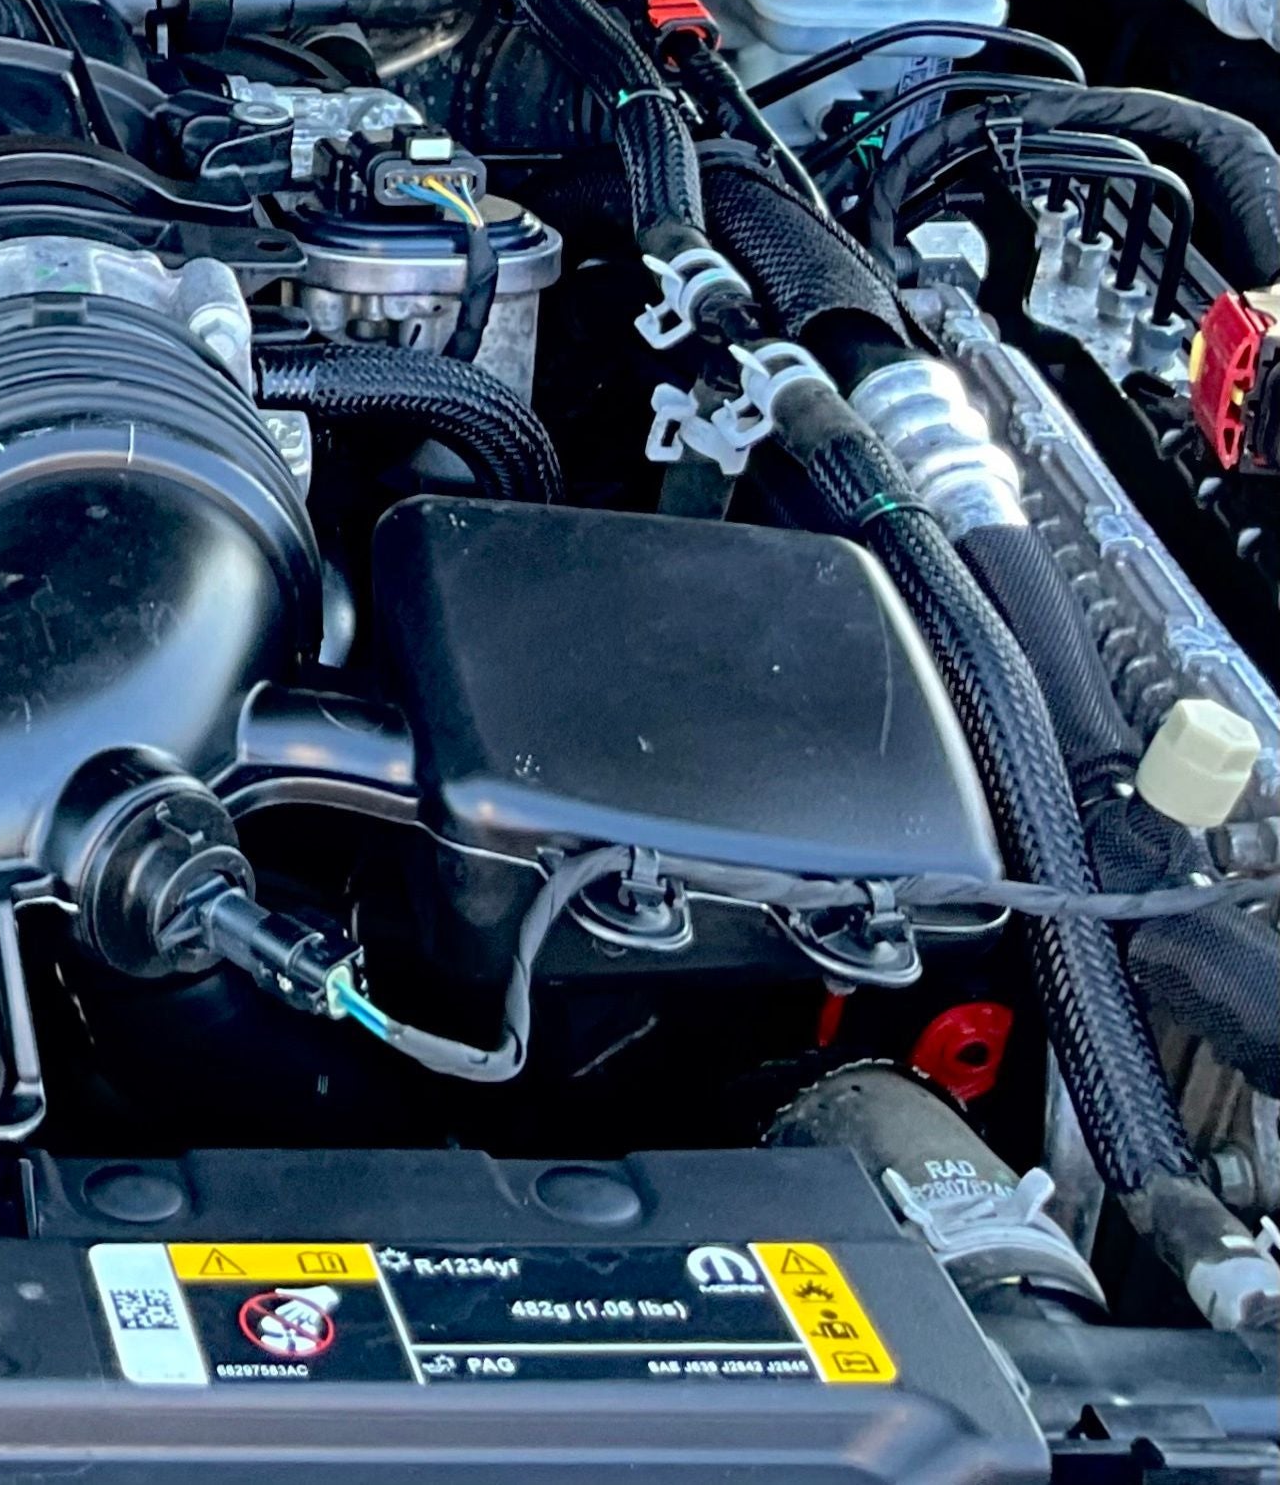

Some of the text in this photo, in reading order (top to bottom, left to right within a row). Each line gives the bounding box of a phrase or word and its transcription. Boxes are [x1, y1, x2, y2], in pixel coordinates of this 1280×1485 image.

[924, 1160, 977, 1179] RAD
[413, 1257, 521, 1278] R-1234yf
[511, 1299, 572, 1321] 482g
[637, 1299, 687, 1321] lbs)
[466, 1357, 516, 1375] PAG
